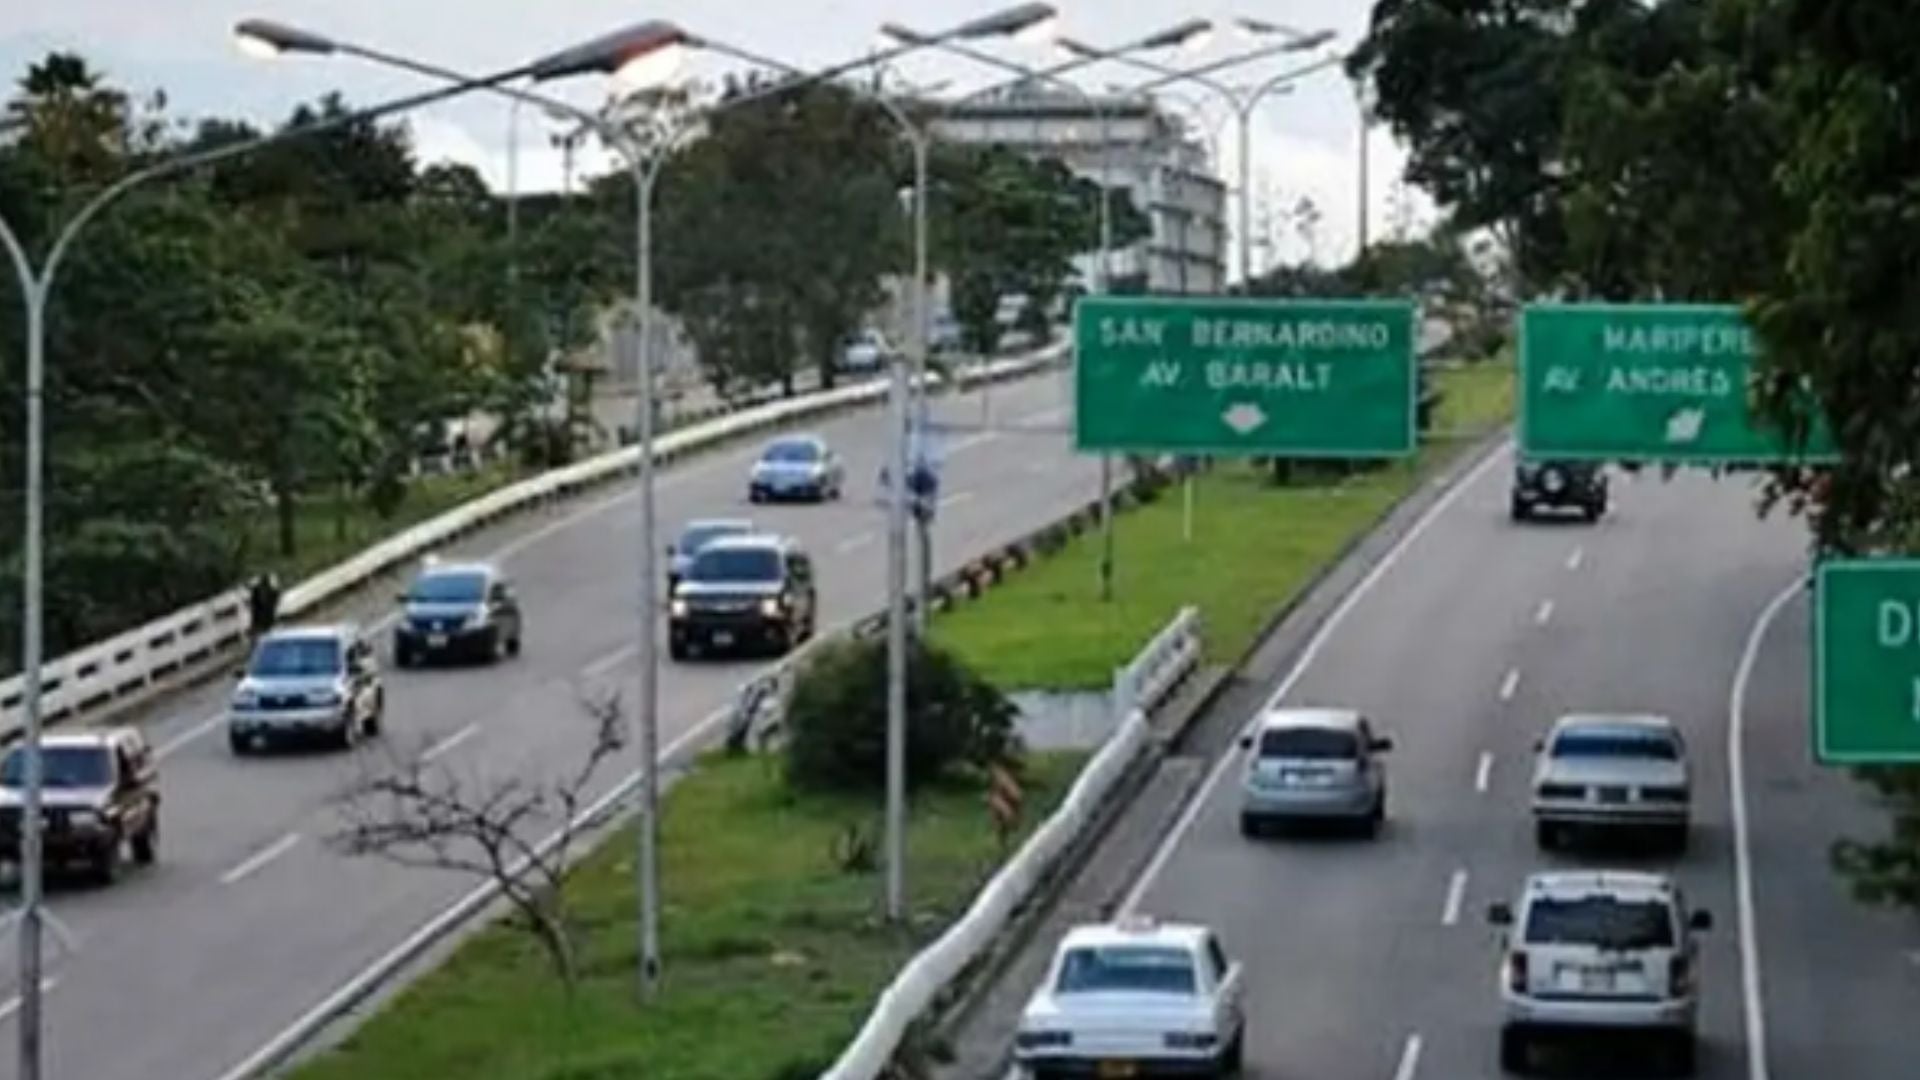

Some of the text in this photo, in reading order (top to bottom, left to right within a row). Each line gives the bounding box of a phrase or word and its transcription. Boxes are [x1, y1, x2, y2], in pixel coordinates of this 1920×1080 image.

[1099, 317, 1389, 349] SAN BERNARDINO
[1207, 361, 1332, 390] BARALT
